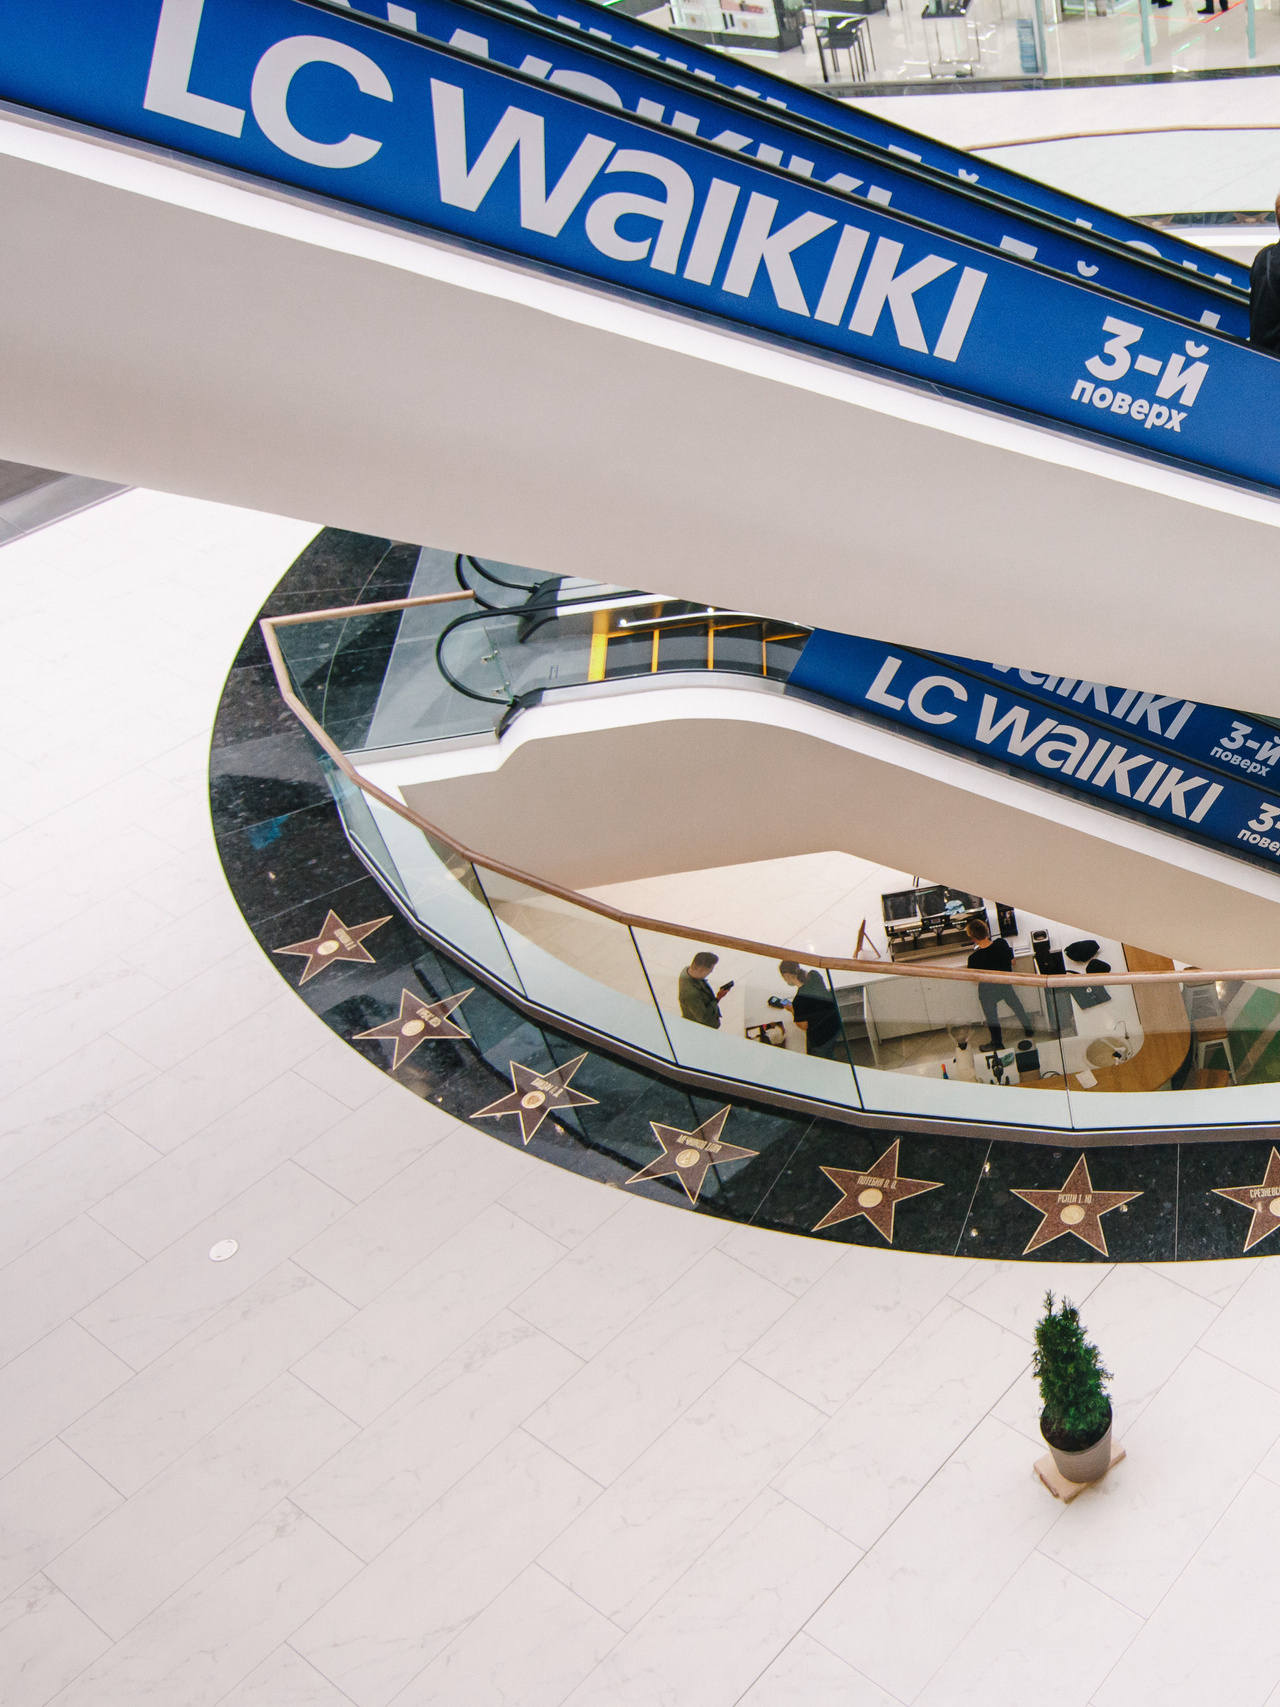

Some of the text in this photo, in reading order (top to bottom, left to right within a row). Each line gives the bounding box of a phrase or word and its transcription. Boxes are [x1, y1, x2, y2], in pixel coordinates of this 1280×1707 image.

[143, 0, 393, 169] LC
[1070, 379, 1189, 432] поверх
[865, 655, 969, 725] LC
[1210, 746, 1271, 777] поверх
